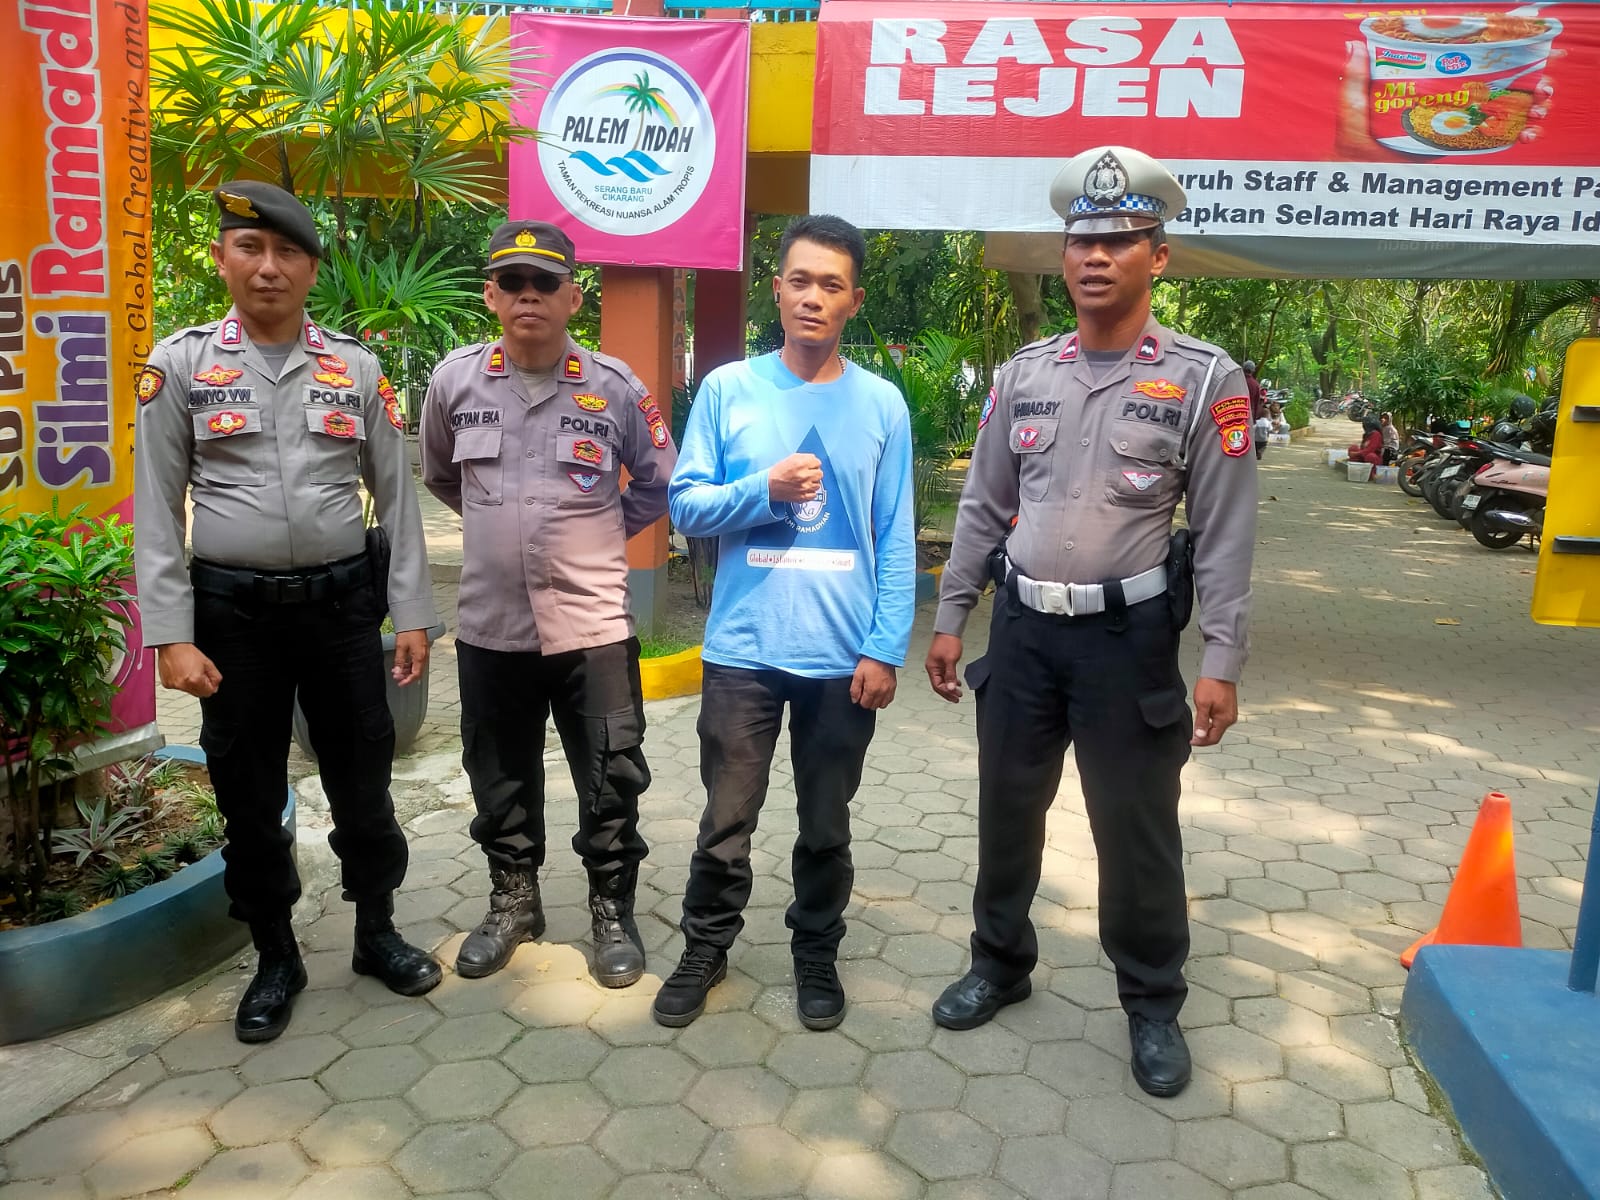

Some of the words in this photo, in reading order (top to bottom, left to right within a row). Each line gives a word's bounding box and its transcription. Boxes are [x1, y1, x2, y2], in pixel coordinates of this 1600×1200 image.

[115, 1, 145, 69] and
[870, 15, 1245, 65] RASA
[863, 66, 1245, 118] LEJEN
[1375, 82, 1416, 98] Mi
[1375, 90, 1470, 113] goreng
[562, 116, 630, 144] PALEM
[121, 80, 147, 219] Creative
[557, 160, 577, 192] TAMAN
[574, 189, 614, 217] REKREASI
[616, 208, 651, 219] NUANSA
[653, 194, 676, 213] ALAM
[673, 165, 695, 196] TROPIS
[594, 185, 628, 194] SERANG
[602, 193, 645, 203] CIKARANG
[1244, 170, 1318, 191] Staff
[1328, 172, 1350, 192] &
[1361, 173, 1563, 201] Management
[1275, 204, 1399, 227] Selamat
[1409, 207, 1473, 230] Hari
[1483, 209, 1560, 236] Raya
[34, 314, 111, 486] Silmi
[228, 389, 251, 402] VW
[309, 389, 361, 408] POLRI
[482, 410, 500, 424] EKA
[560, 415, 609, 437] POLRI
[1122, 400, 1181, 426] POLRI
